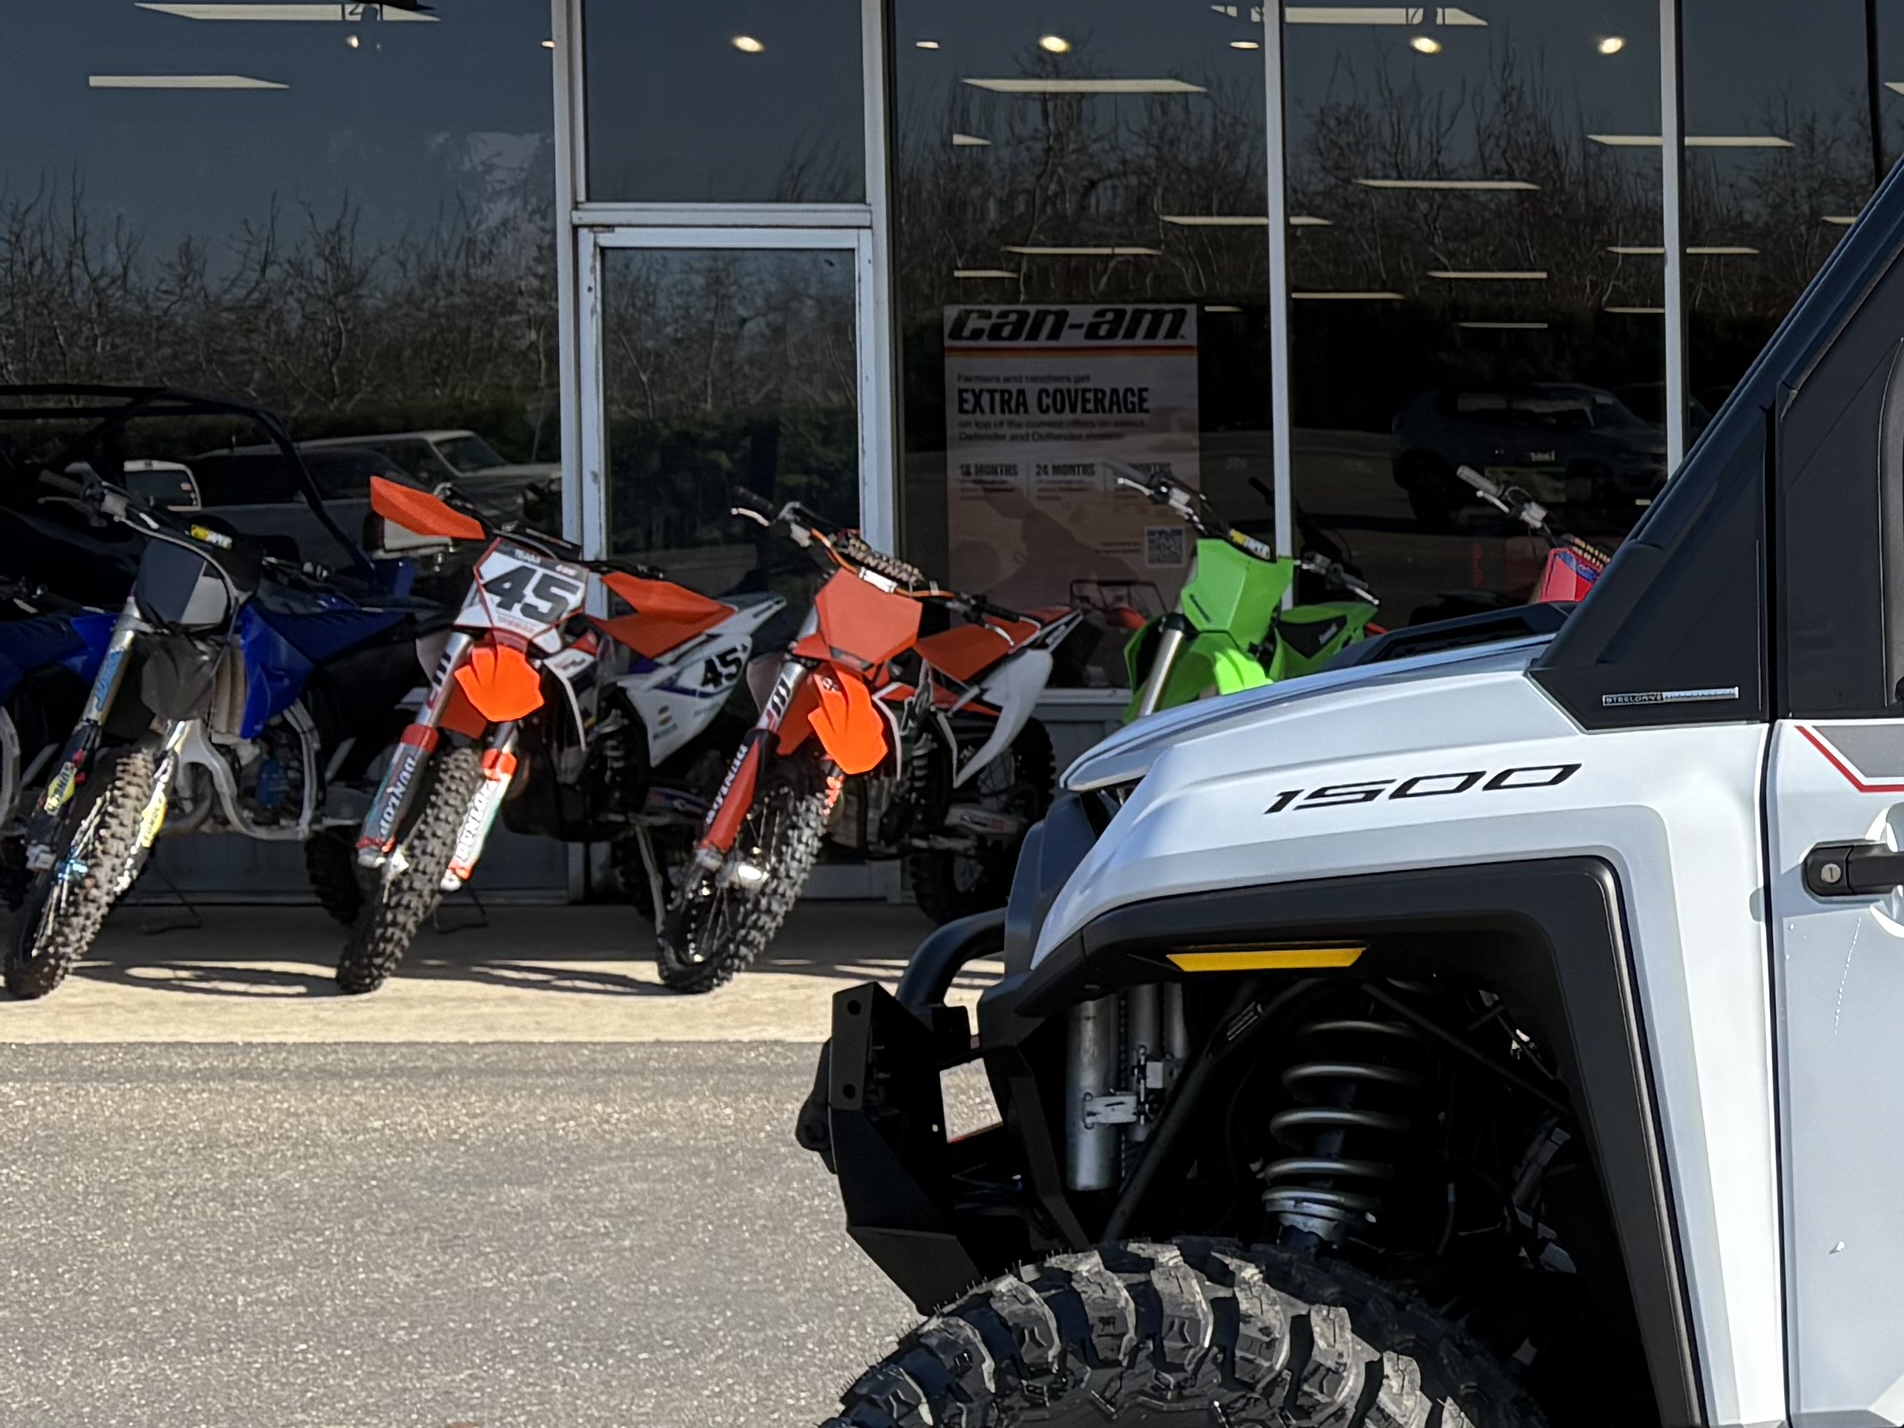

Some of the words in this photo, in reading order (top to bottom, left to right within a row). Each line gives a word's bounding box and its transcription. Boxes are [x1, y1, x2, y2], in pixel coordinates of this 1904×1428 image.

[948, 308, 1187, 341] can-am
[957, 388, 1029, 415] EXTRA
[1037, 387, 1150, 415] COVERAGE
[482, 564, 580, 625] 45
[700, 646, 743, 690] 45
[379, 756, 418, 837] DUNLOP
[1264, 762, 1582, 815] 1500
